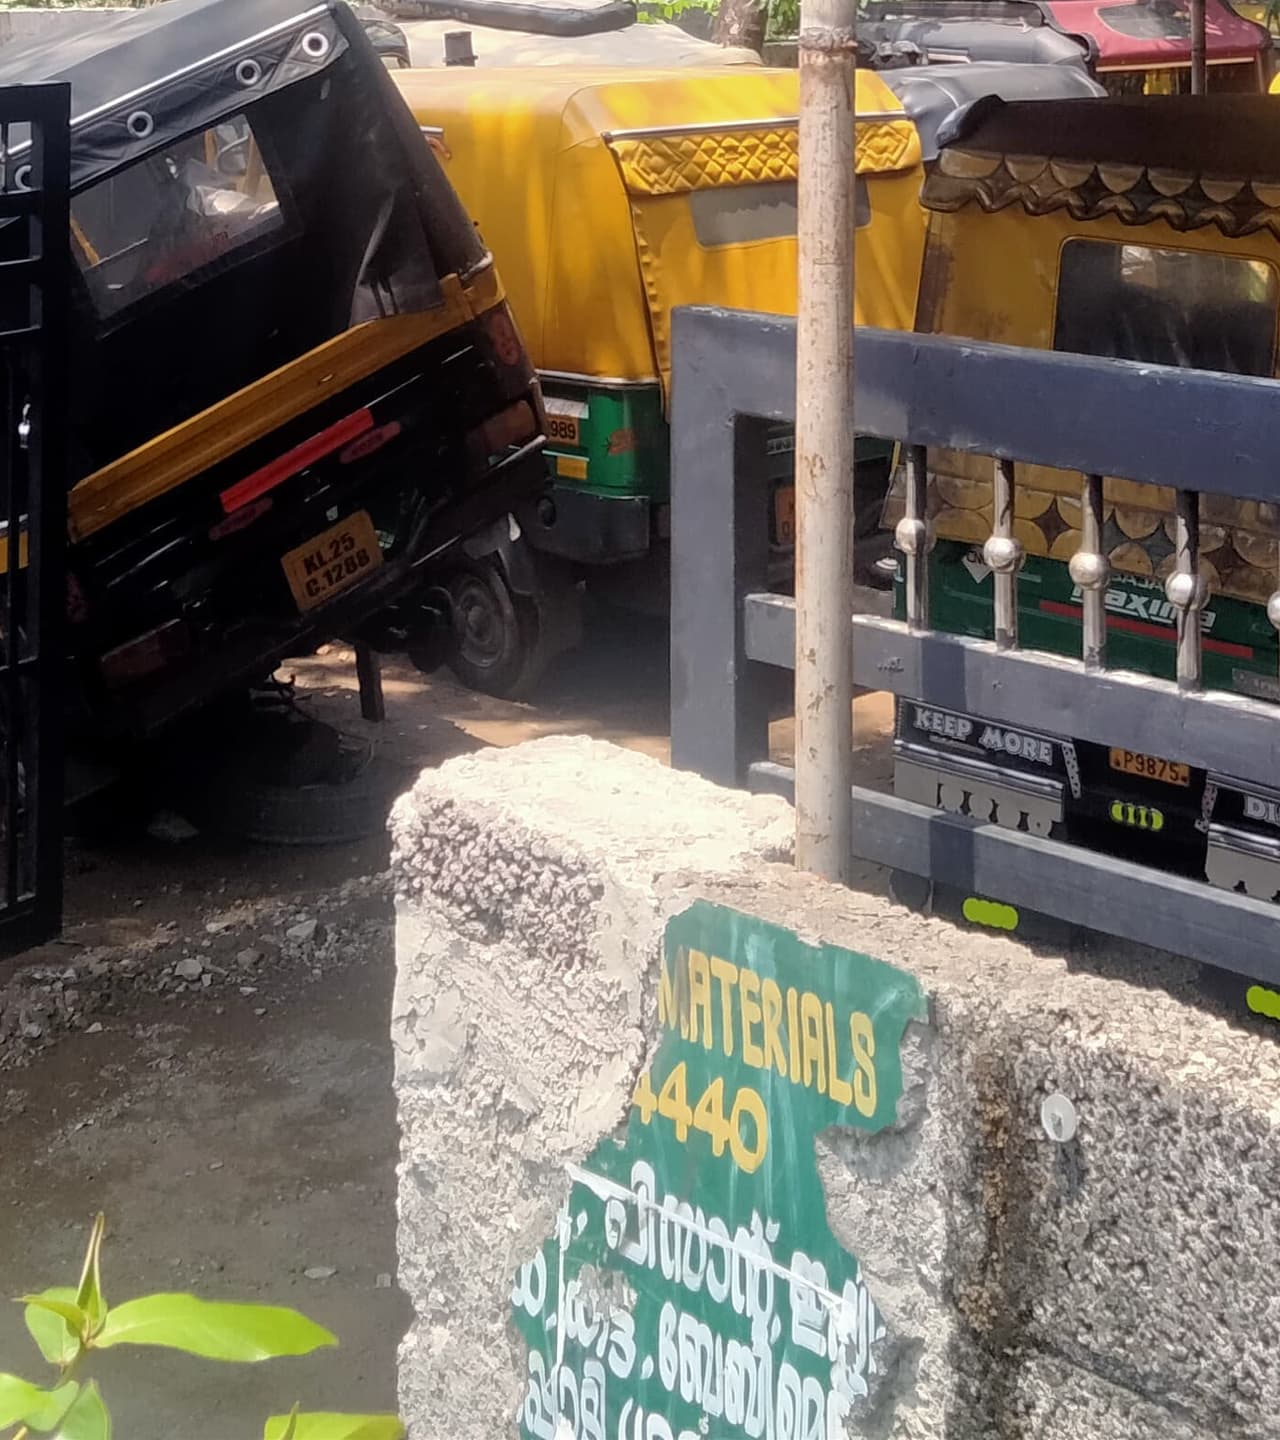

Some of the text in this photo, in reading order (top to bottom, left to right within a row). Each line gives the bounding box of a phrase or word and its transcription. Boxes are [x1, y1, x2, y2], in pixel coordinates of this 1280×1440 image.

[549, 420, 577, 440] 989
[913, 706, 1054, 766] KEEP MORE
